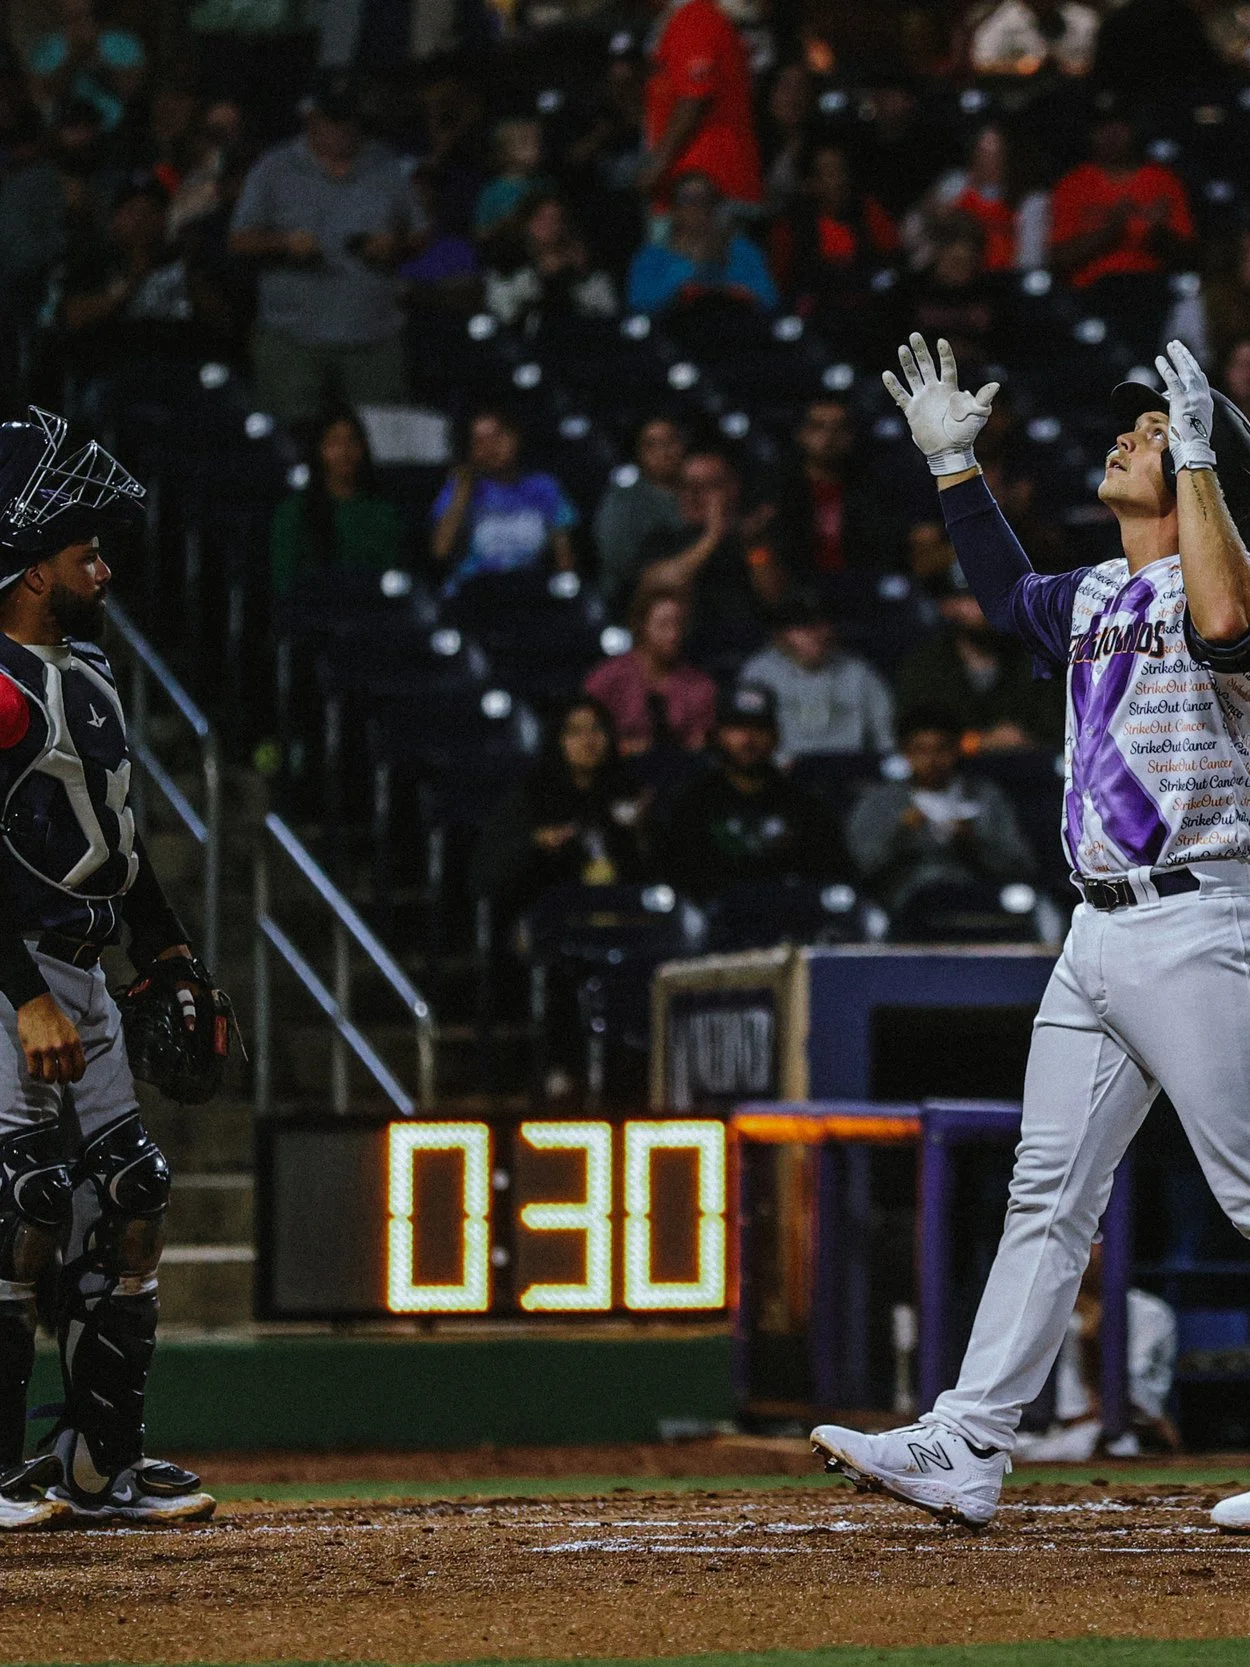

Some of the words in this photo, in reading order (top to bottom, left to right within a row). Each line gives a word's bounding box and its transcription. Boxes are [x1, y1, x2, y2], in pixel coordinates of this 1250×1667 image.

[1141, 659, 1189, 676] StrikeOu
[1135, 679, 1189, 696] StrikeOut
[1129, 699, 1181, 716] StrikeOut
[1182, 699, 1214, 713] Cancer
[1123, 720, 1173, 736] StrikeOut
[1130, 738, 1181, 755] StrikeOut
[1182, 738, 1217, 752] Cancer
[1147, 757, 1197, 774] StrikeOut
[1199, 756, 1233, 770] Cancer
[1159, 777, 1208, 793] StrikeOut
[1181, 811, 1236, 830] StrikeOut
[1175, 831, 1232, 847] StrikeOut
